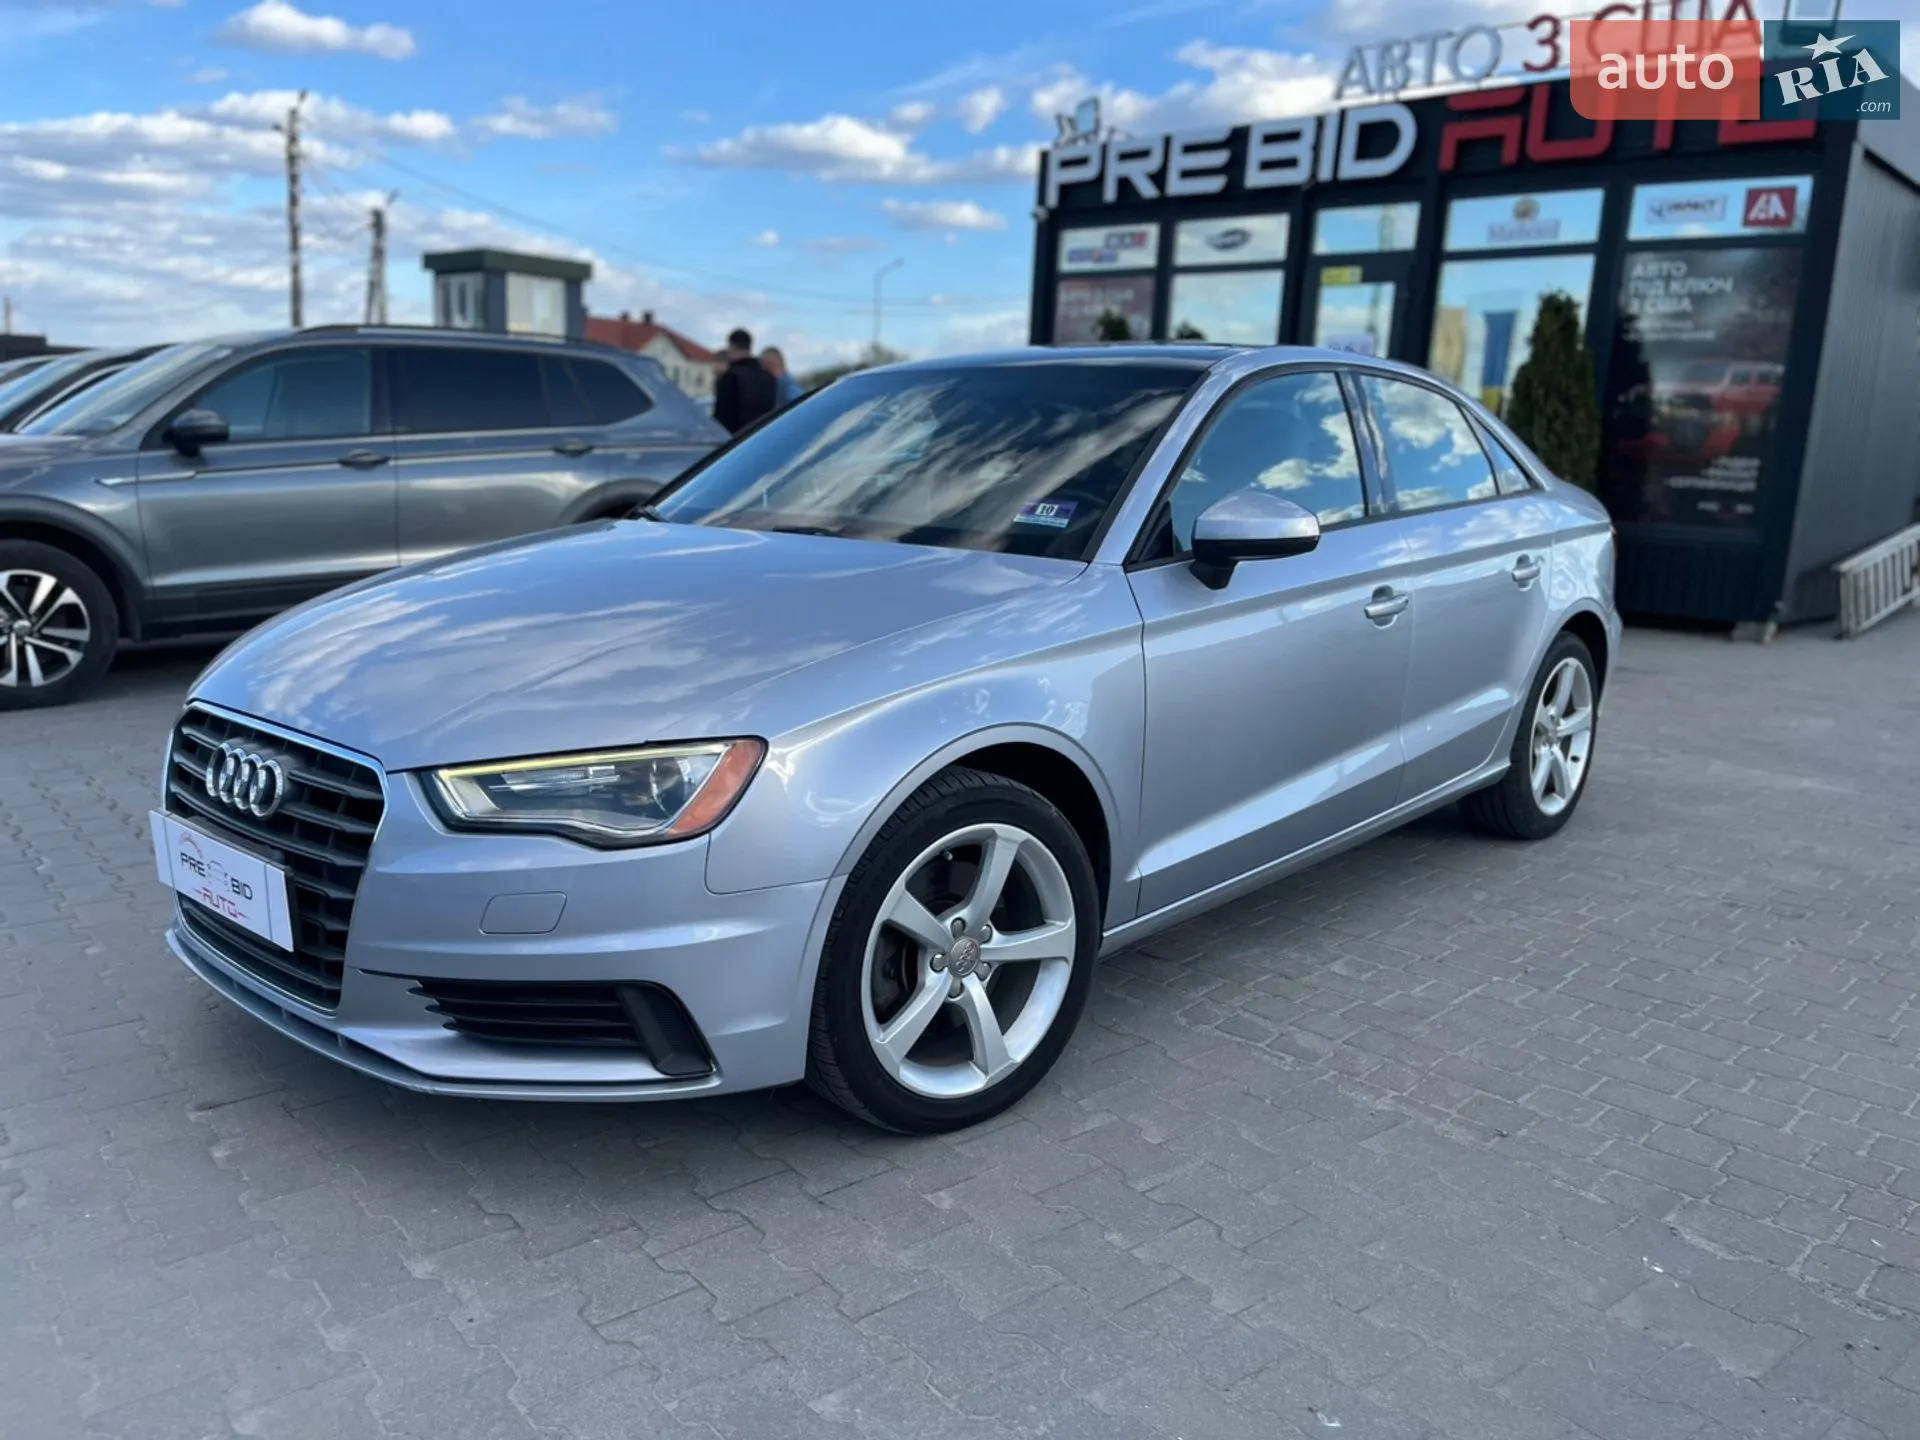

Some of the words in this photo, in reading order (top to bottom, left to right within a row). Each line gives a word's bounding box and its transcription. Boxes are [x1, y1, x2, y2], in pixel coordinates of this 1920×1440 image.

[1336, 24, 1503, 99] АВТО
[1045, 126, 1232, 209] PRE
[1244, 103, 1418, 190] BID
[180, 851, 206, 878] PRE
[231, 876, 254, 901] BID
[203, 887, 238, 918] AUTO
